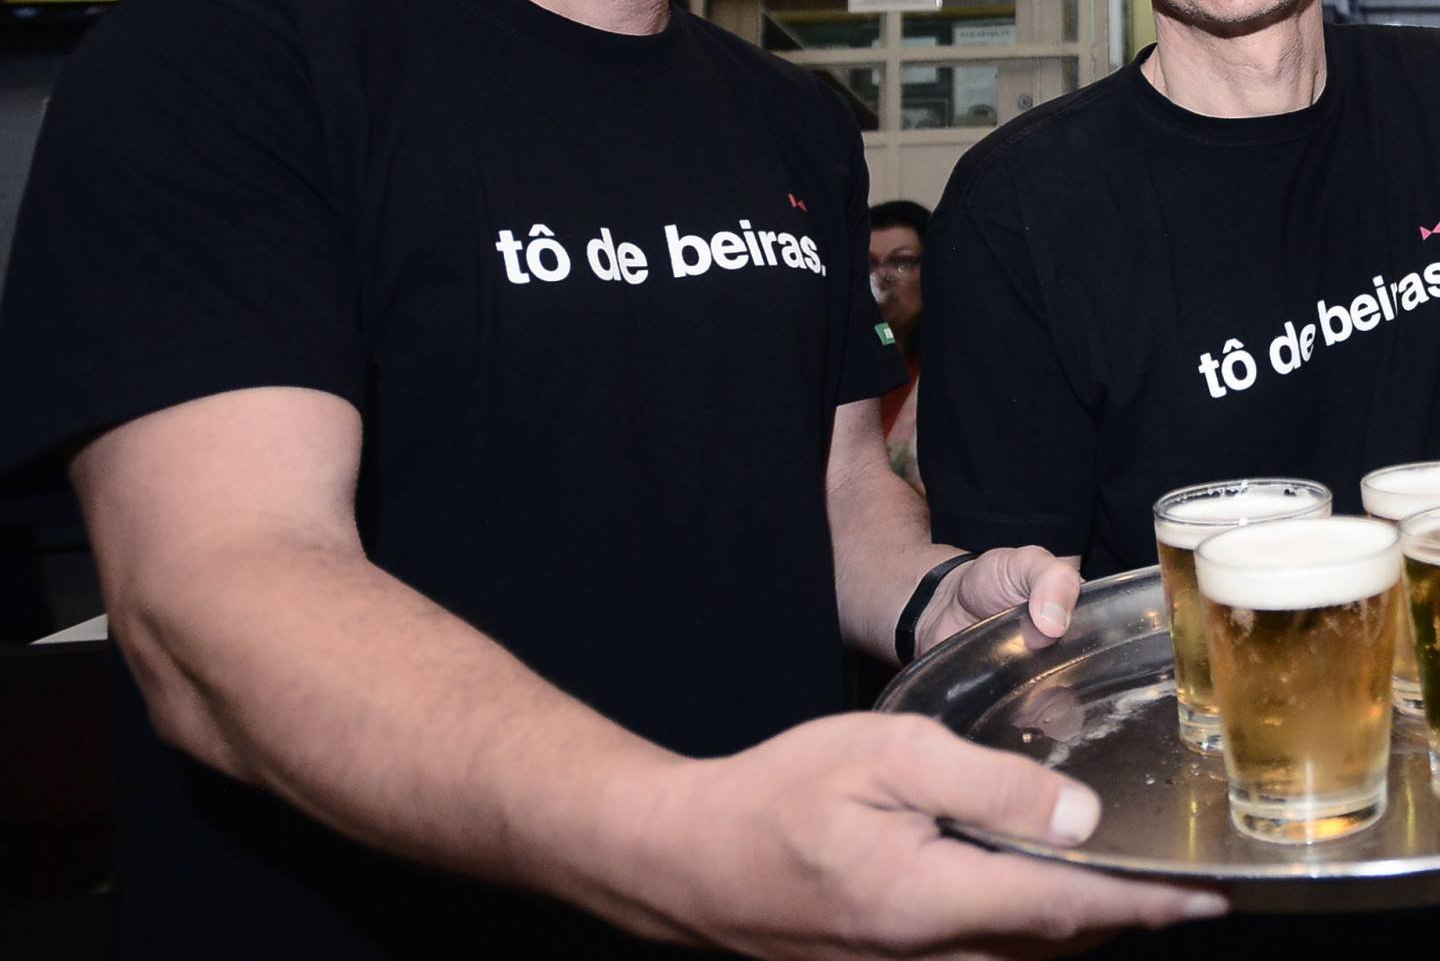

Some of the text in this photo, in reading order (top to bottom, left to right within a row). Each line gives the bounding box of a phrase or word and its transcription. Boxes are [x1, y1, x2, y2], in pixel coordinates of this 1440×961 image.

[495, 224, 571, 284] tô
[586, 227, 649, 285] de
[1198, 338, 1257, 399] tô
[1269, 321, 1316, 375] de
